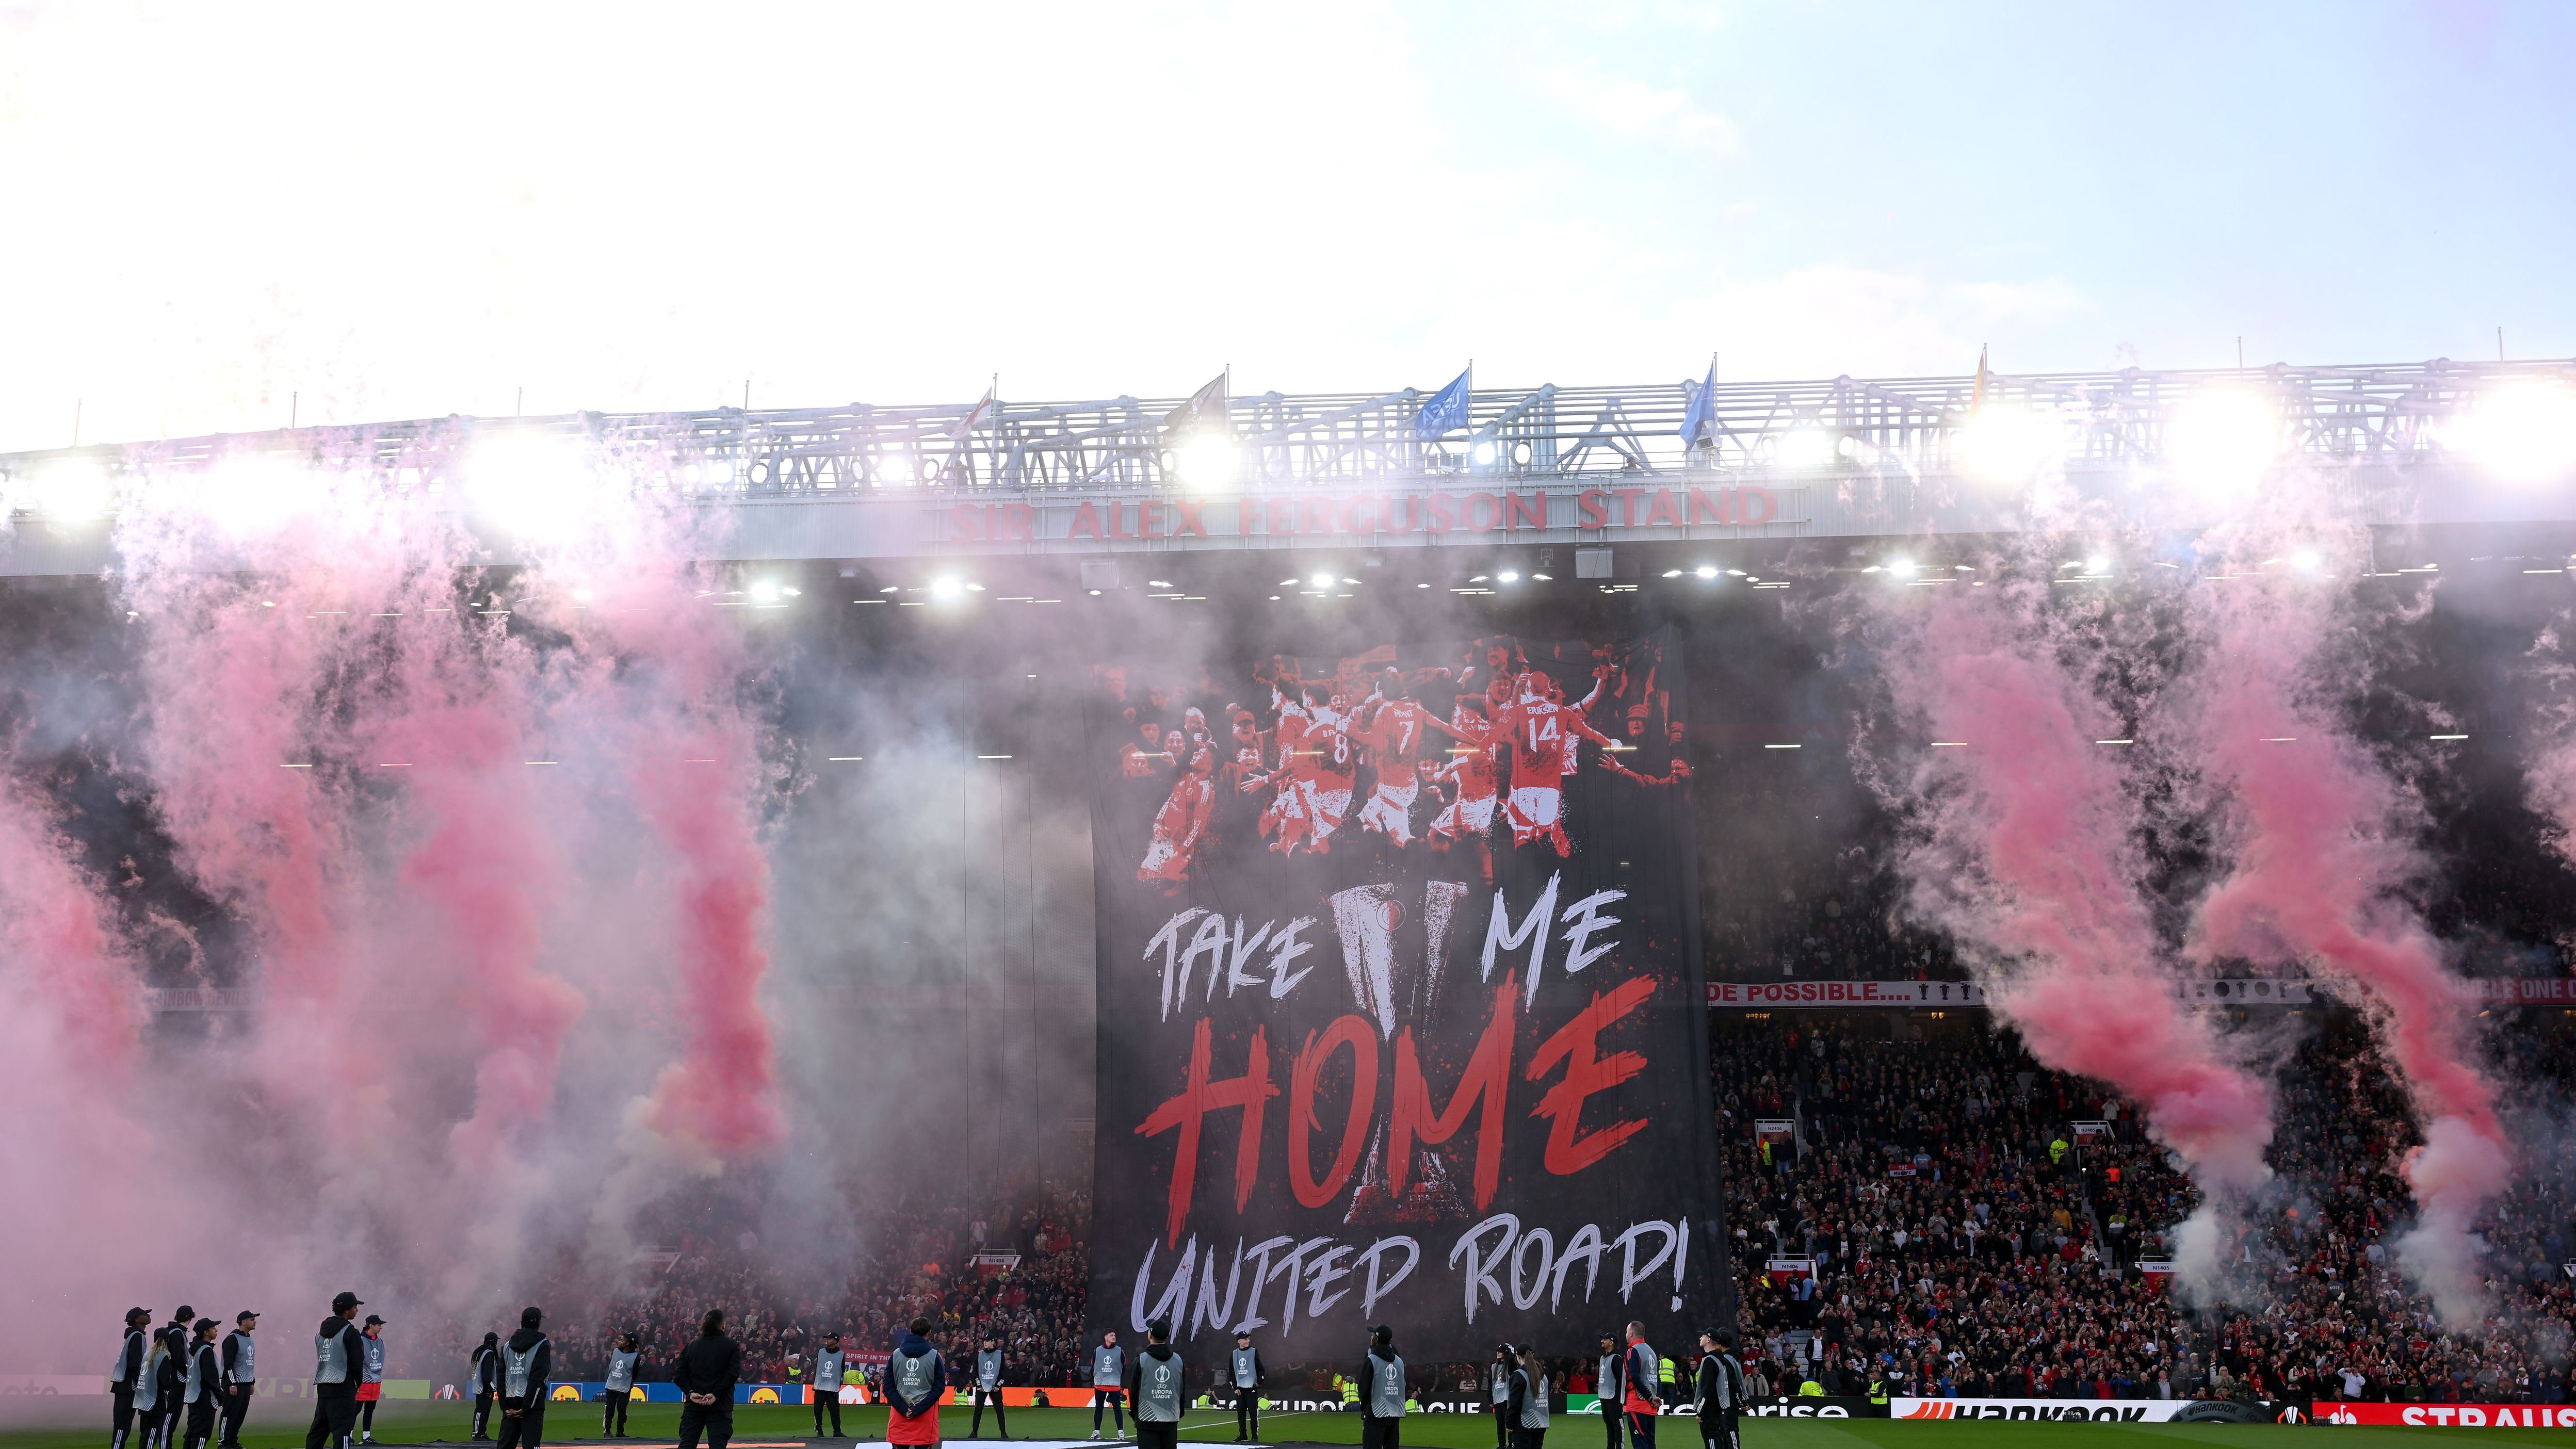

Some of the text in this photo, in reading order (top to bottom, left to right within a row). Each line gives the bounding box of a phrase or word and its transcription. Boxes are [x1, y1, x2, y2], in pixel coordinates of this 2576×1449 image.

[950, 486, 1778, 542] SIR ALEX FERGUSON STAND
[1526, 704, 1559, 714] ERIKSEN
[1335, 734, 1348, 763] 8
[1399, 721, 1414, 754] 7
[1528, 716, 1561, 753] 14
[1143, 869, 1628, 1022] TAKE ME
[2521, 980, 2563, 999] ONE
[1135, 967, 1657, 1250] HOME
[1131, 1213, 1689, 1343] UNITED ROAD!
